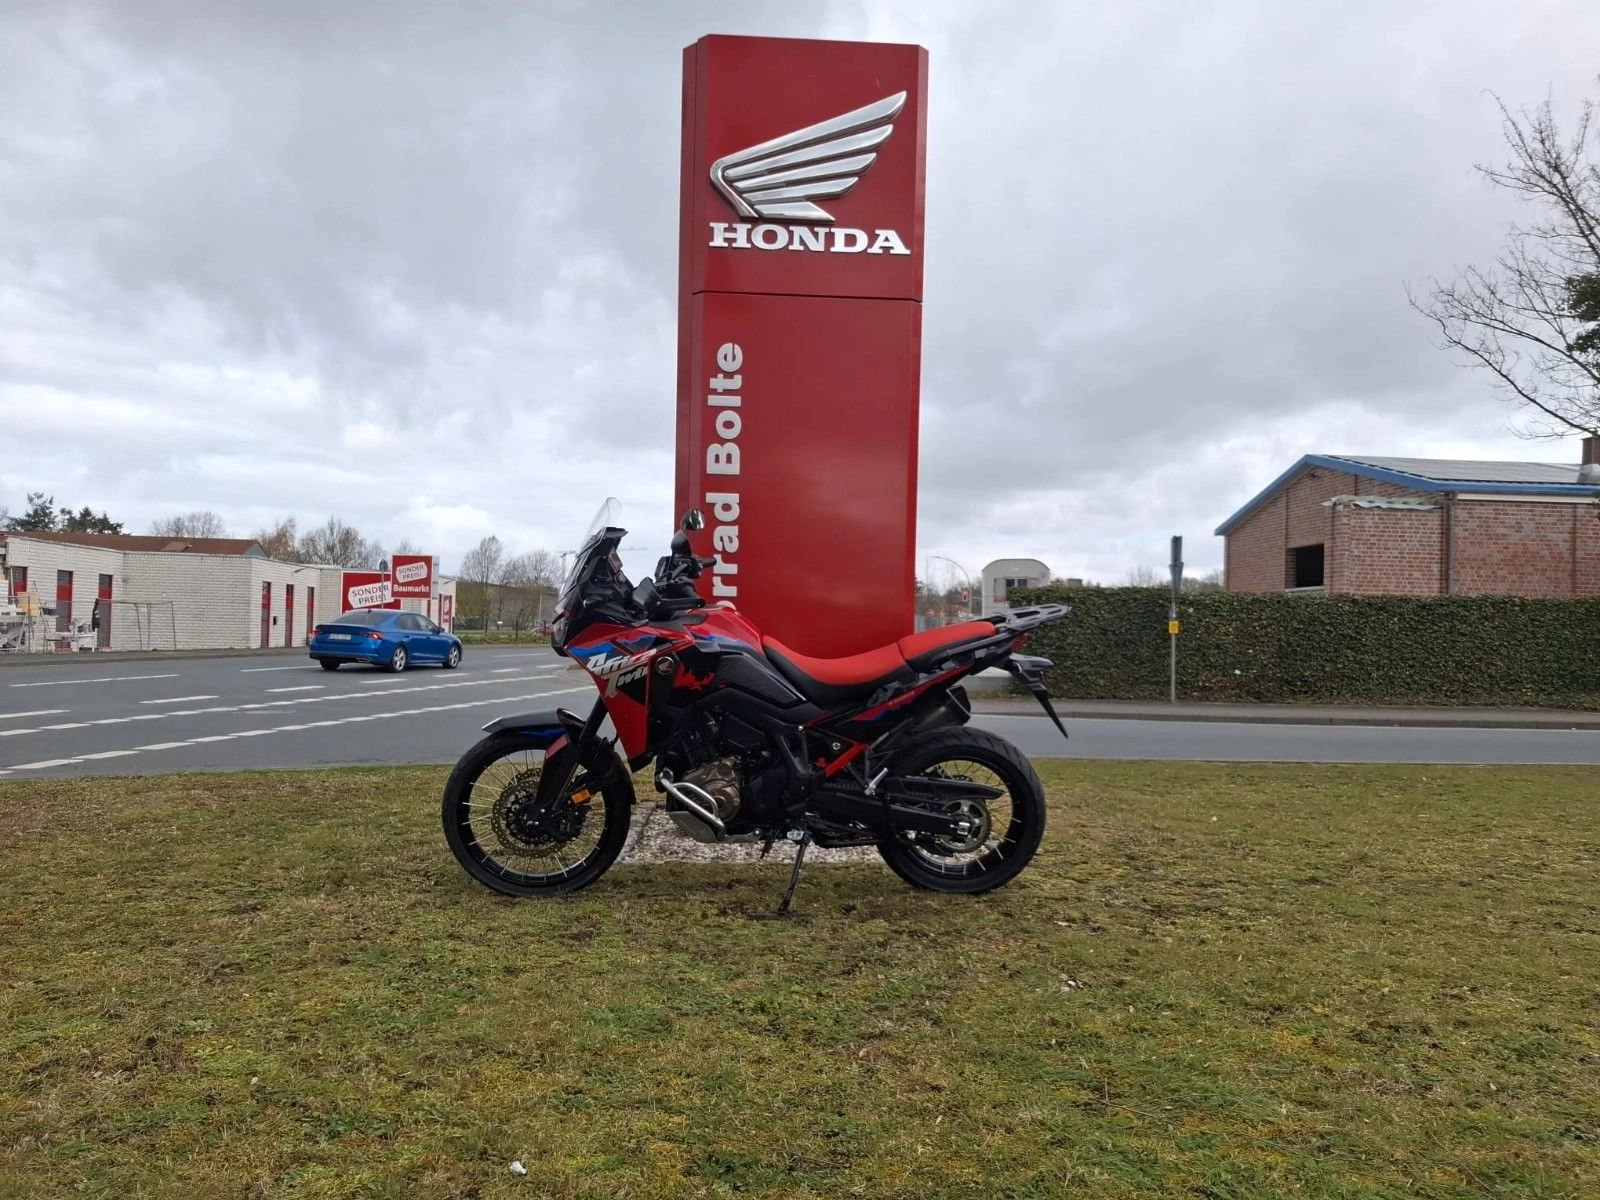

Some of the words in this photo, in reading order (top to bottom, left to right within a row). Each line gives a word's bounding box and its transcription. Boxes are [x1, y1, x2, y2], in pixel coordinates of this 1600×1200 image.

[709, 222, 911, 254] HONDA
[706, 342, 743, 475] Bolte
[398, 564, 424, 574] SONDER
[352, 584, 390, 597] SONDER
[393, 584, 430, 593] Baumarkt
